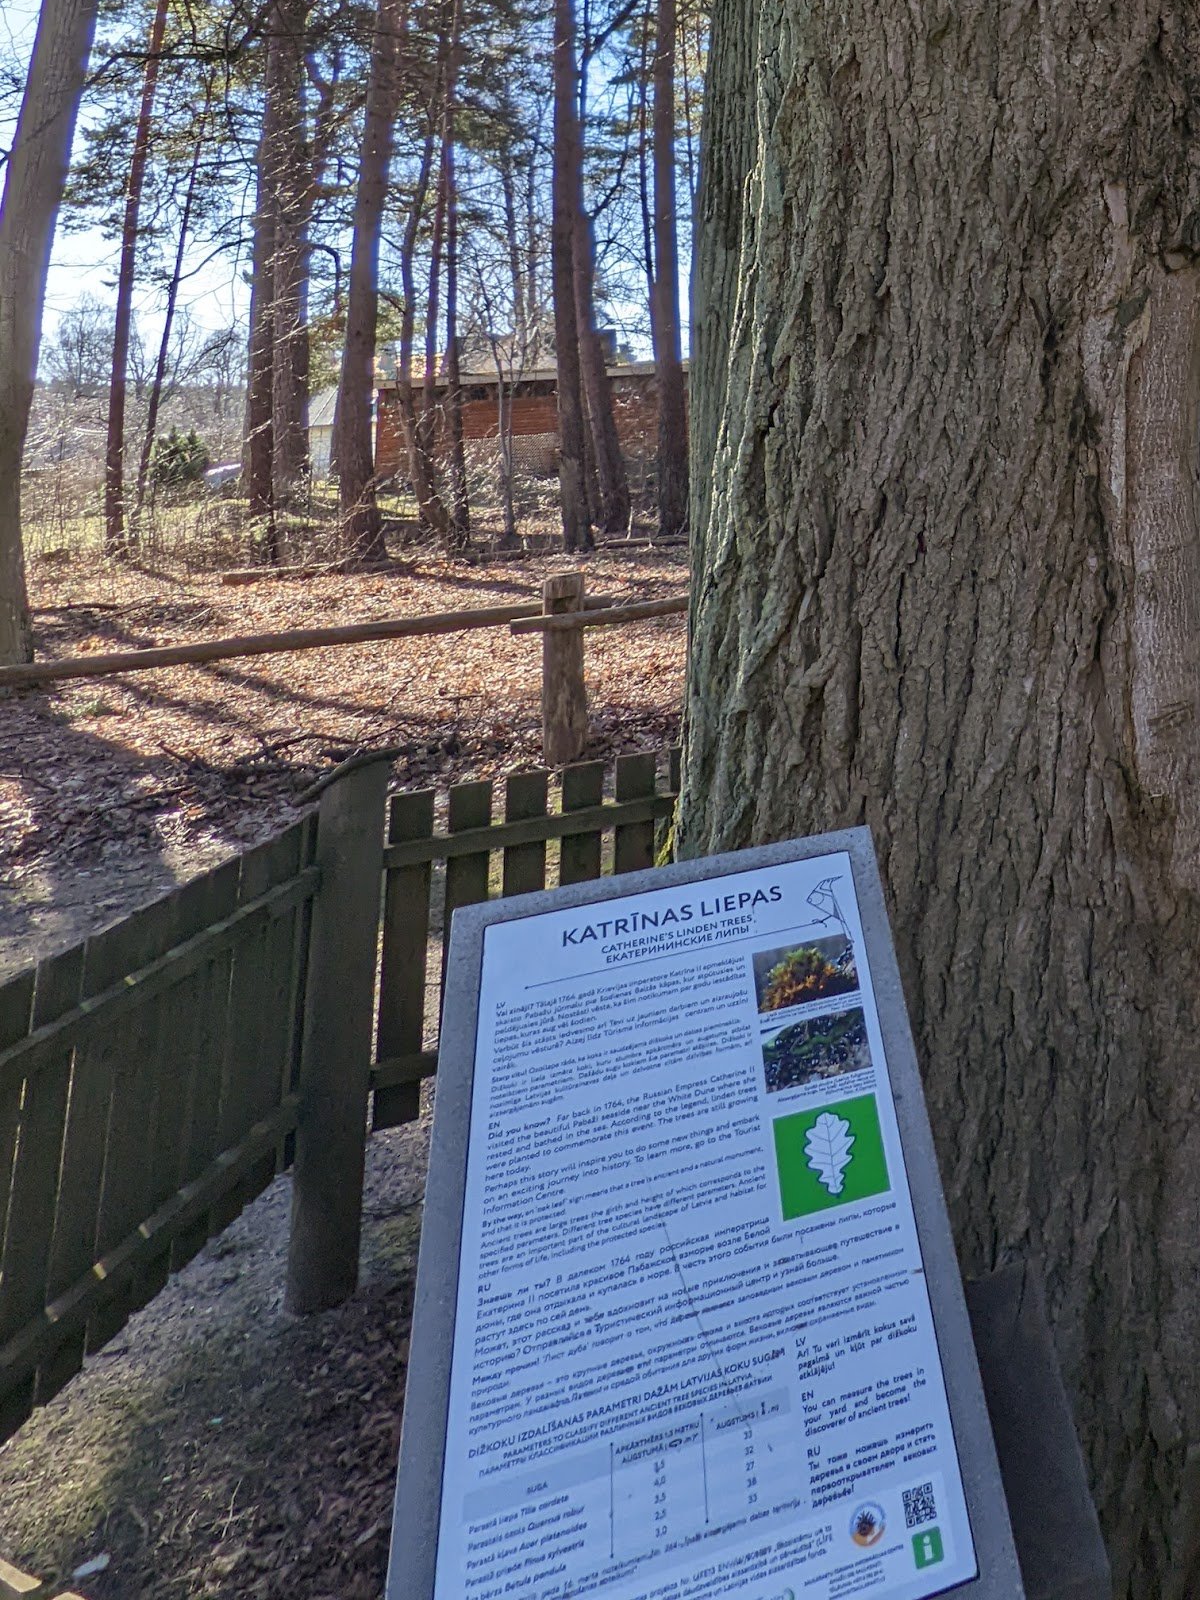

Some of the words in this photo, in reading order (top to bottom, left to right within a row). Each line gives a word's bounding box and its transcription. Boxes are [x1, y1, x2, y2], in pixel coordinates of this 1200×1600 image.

[563, 905, 692, 945] KATRĪNAS
[701, 886, 782, 916] LIEPAS
[677, 922, 718, 937] LINDEN
[720, 915, 752, 927] TREES
[606, 934, 712, 963] ЕКАТЕРИНИНСКИЕ
[715, 926, 749, 939] ЛИПЫ
[487, 1148, 513, 1160] rested
[515, 1143, 531, 1153] and
[534, 1135, 563, 1148] bathed
[576, 1129, 590, 1137] the
[611, 1114, 651, 1128] According
[681, 1098, 709, 1110] legend,
[711, 1091, 736, 1102] linden
[738, 1086, 757, 1095] trees
[488, 1130, 503, 1140] Did
[506, 1128, 521, 1137] you
[524, 1118, 551, 1131] know?
[557, 1114, 570, 1122] Far
[572, 1108, 590, 1118] back
[604, 1100, 625, 1109] 1764,
[643, 1089, 673, 1100] Russian
[675, 1080, 708, 1092] Empress
[710, 1070, 747, 1083] Catherine
[488, 1138, 515, 1150] visited
[534, 1123, 570, 1138] beautiful
[601, 1109, 631, 1120] seaside
[633, 1104, 650, 1112] near
[668, 1093, 692, 1103] White
[694, 1087, 715, 1097] Dune
[717, 1081, 741, 1091] where
[486, 1161, 507, 1170] were
[508, 1151, 540, 1166] planted
[554, 1134, 612, 1153] commemorate
[614, 1129, 629, 1137] this
[658, 1117, 673, 1125] The
[675, 1112, 695, 1121] trees
[697, 1108, 709, 1116] are
[711, 1102, 726, 1112] still
[728, 1096, 758, 1109] growing
[488, 1121, 500, 1130] EN
[485, 1180, 518, 1192] Perhaps
[520, 1175, 536, 1184] this
[538, 1169, 559, 1179] story
[561, 1163, 576, 1173] will
[578, 1157, 606, 1168] inspire
[608, 1152, 623, 1162] you
[648, 1140, 670, 1149] some
[671, 1135, 688, 1143] new
[690, 1128, 714, 1138] things
[716, 1122, 730, 1132] and
[732, 1115, 760, 1127] embark
[511, 1183, 545, 1197] exciting
[547, 1174, 580, 1189] journey
[582, 1169, 599, 1177] into
[634, 1155, 645, 1163] To
[647, 1151, 667, 1160] learn
[670, 1145, 693, 1153] more,
[695, 1140, 705, 1149] go
[718, 1133, 732, 1141] the
[734, 1125, 761, 1136] Tourist
[485, 1172, 504, 1181] here
[506, 1166, 531, 1176] today.
[483, 1197, 534, 1214] Information
[478, 1284, 491, 1293] RU
[795, 1337, 806, 1347] LV
[812, 1345, 822, 1353] Tu
[844, 1329, 871, 1343] izmērīt
[874, 1322, 896, 1334] kokus
[871, 1337, 883, 1347] par
[888, 1326, 917, 1340] dižkoku
[469, 1436, 515, 1458] DIŽKOKU
[586, 1395, 641, 1419] PARAMETRI
[681, 1367, 723, 1389] LATVIJAS
[724, 1360, 750, 1375] KOKU
[801, 1390, 814, 1402] EN
[802, 1404, 818, 1413] You
[822, 1398, 836, 1407] can
[840, 1386, 873, 1401] measure
[876, 1380, 890, 1389] the
[893, 1372, 913, 1383] trees
[804, 1414, 822, 1427] your
[829, 1404, 847, 1418] yard
[854, 1397, 869, 1408] and
[876, 1386, 906, 1400] become
[913, 1379, 926, 1388] the
[805, 1417, 846, 1436] discoverer
[848, 1411, 856, 1422] of
[858, 1403, 887, 1418] ancient
[888, 1393, 910, 1408] trees!
[745, 1446, 754, 1456] 32
[807, 1446, 821, 1458] RU
